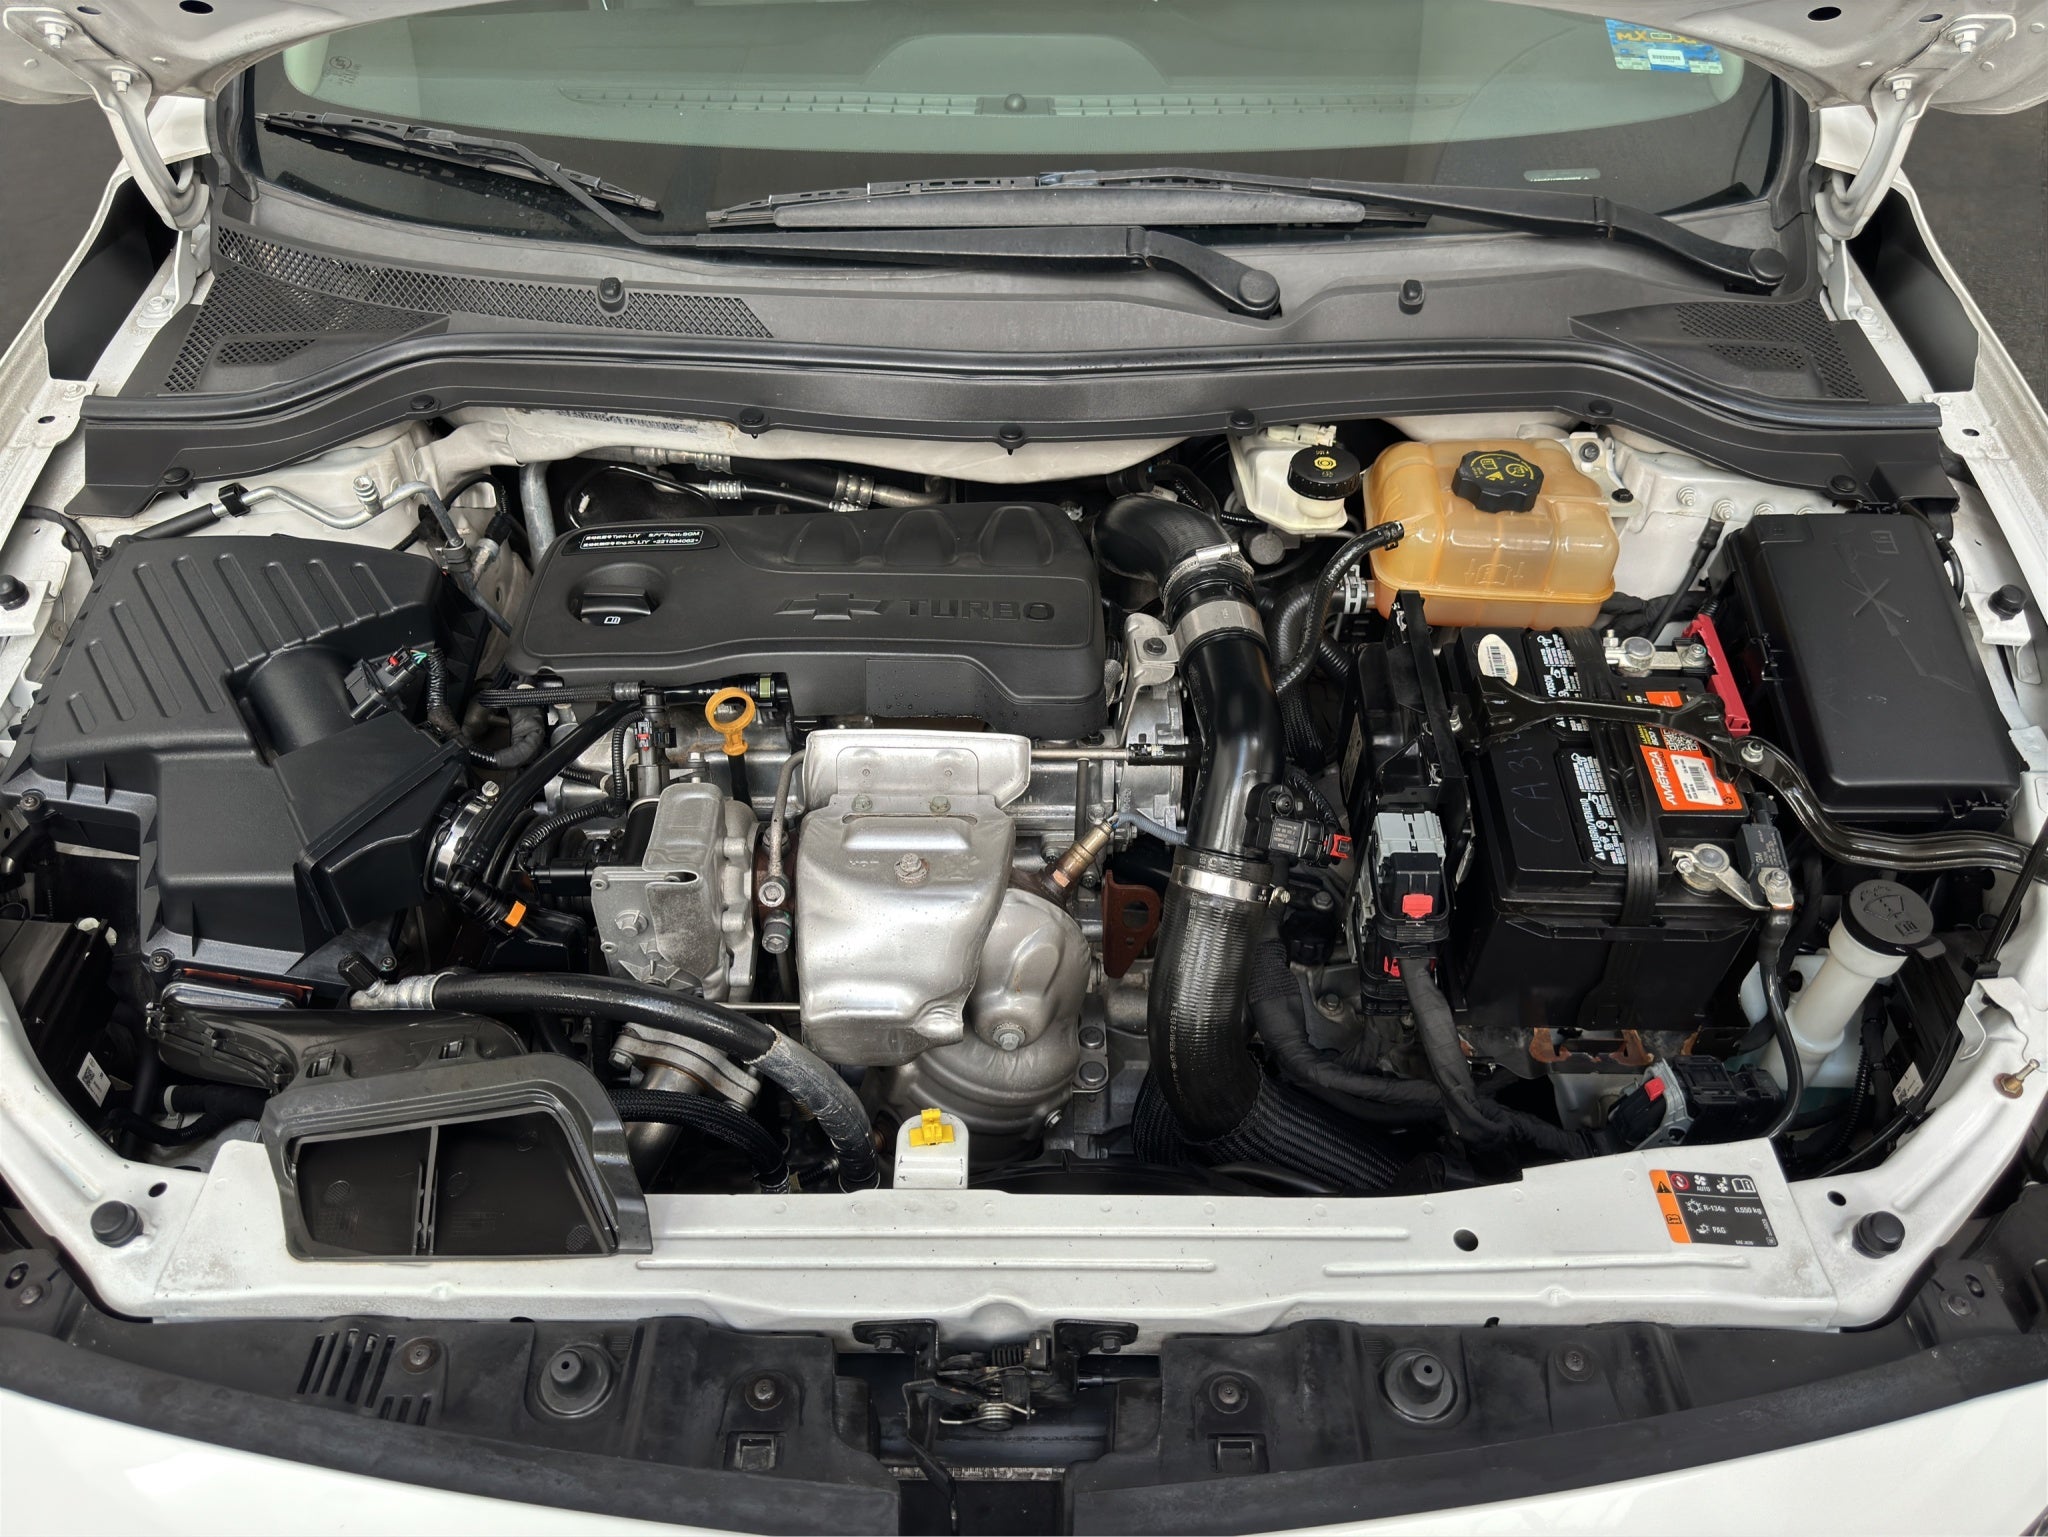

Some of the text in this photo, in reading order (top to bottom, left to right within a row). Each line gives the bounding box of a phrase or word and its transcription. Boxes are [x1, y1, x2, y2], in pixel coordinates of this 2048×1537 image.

[902, 599, 1055, 622] TURBO
[1754, 852, 1764, 864] GM
[1703, 1204, 1726, 1213] R-134a
[1752, 1207, 1762, 1215] kg
[1712, 1226, 1727, 1234] PAG
